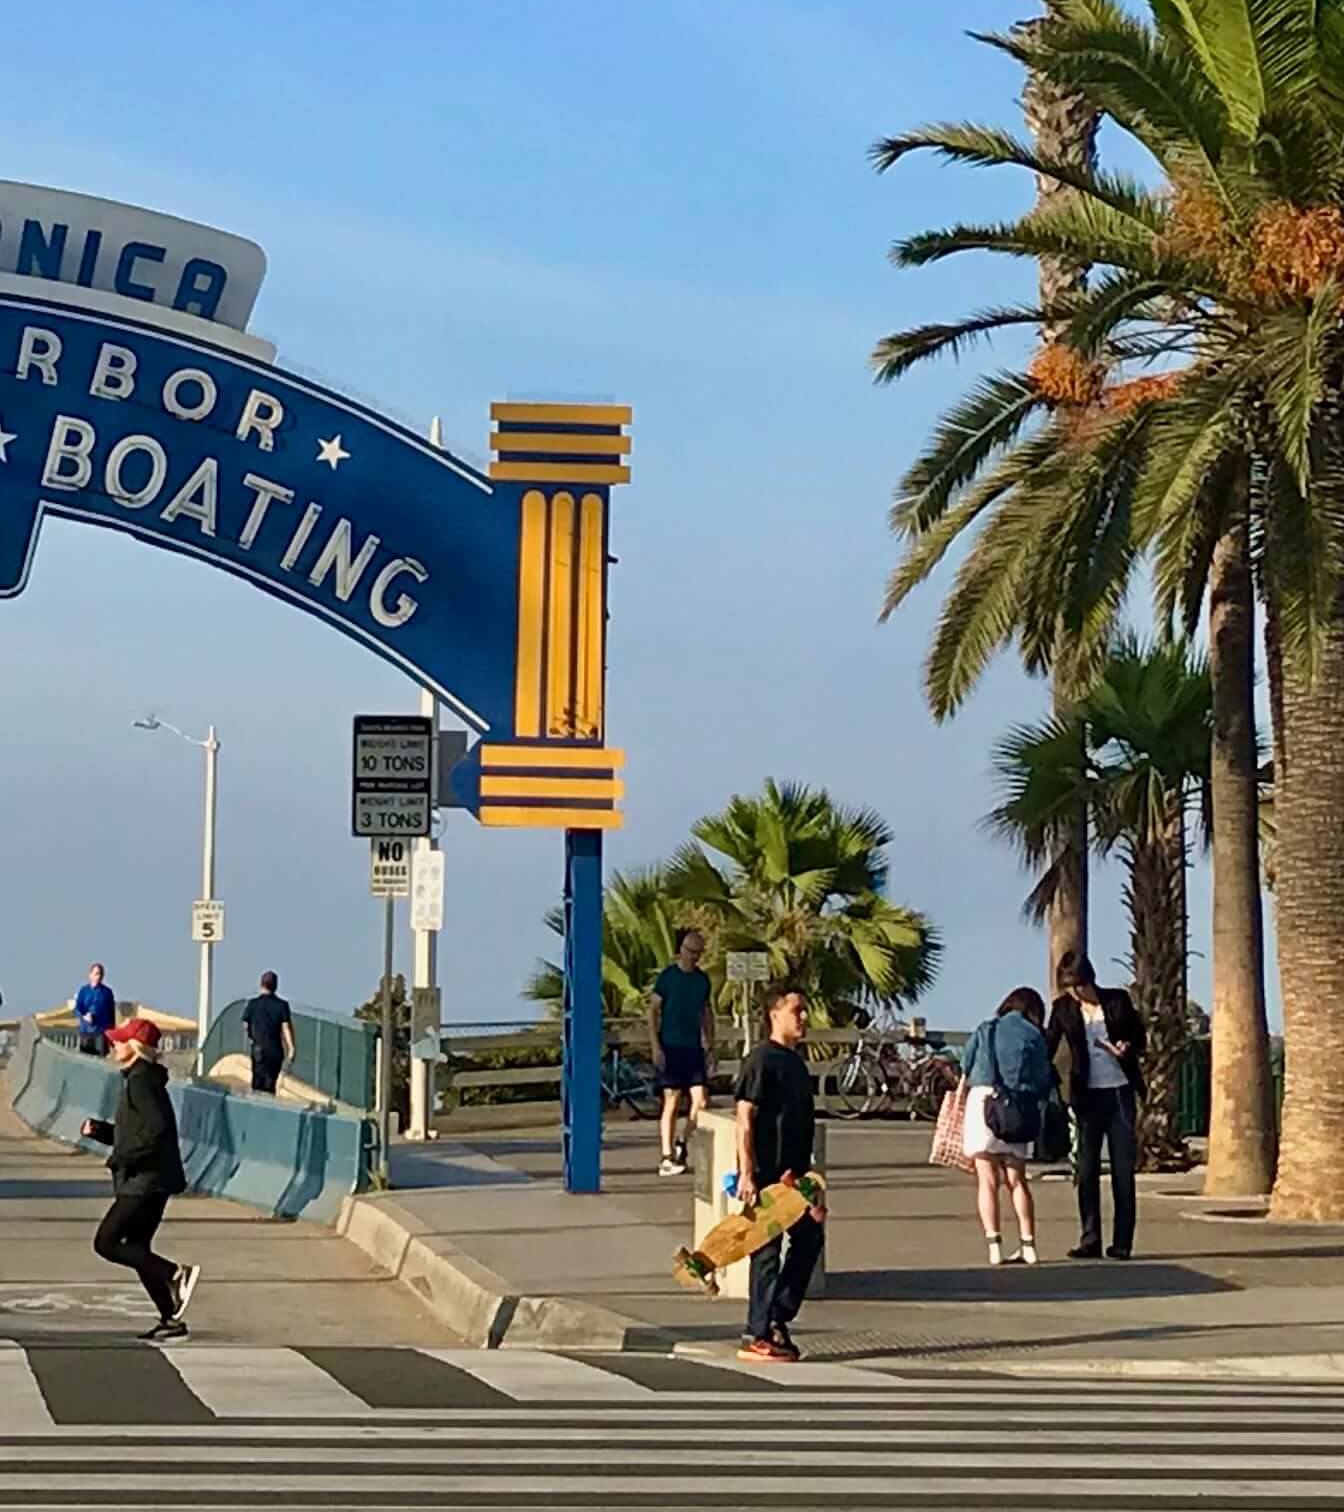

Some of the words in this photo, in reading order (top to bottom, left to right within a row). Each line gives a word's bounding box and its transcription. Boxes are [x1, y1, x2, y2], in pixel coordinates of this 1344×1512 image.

[41, 414, 430, 629] BOATING
[361, 755, 377, 772] 10
[383, 755, 425, 772] TONS
[361, 812, 372, 828] 3
[377, 812, 422, 828] TONS
[378, 841, 404, 862] NO
[202, 921, 215, 938] 5
